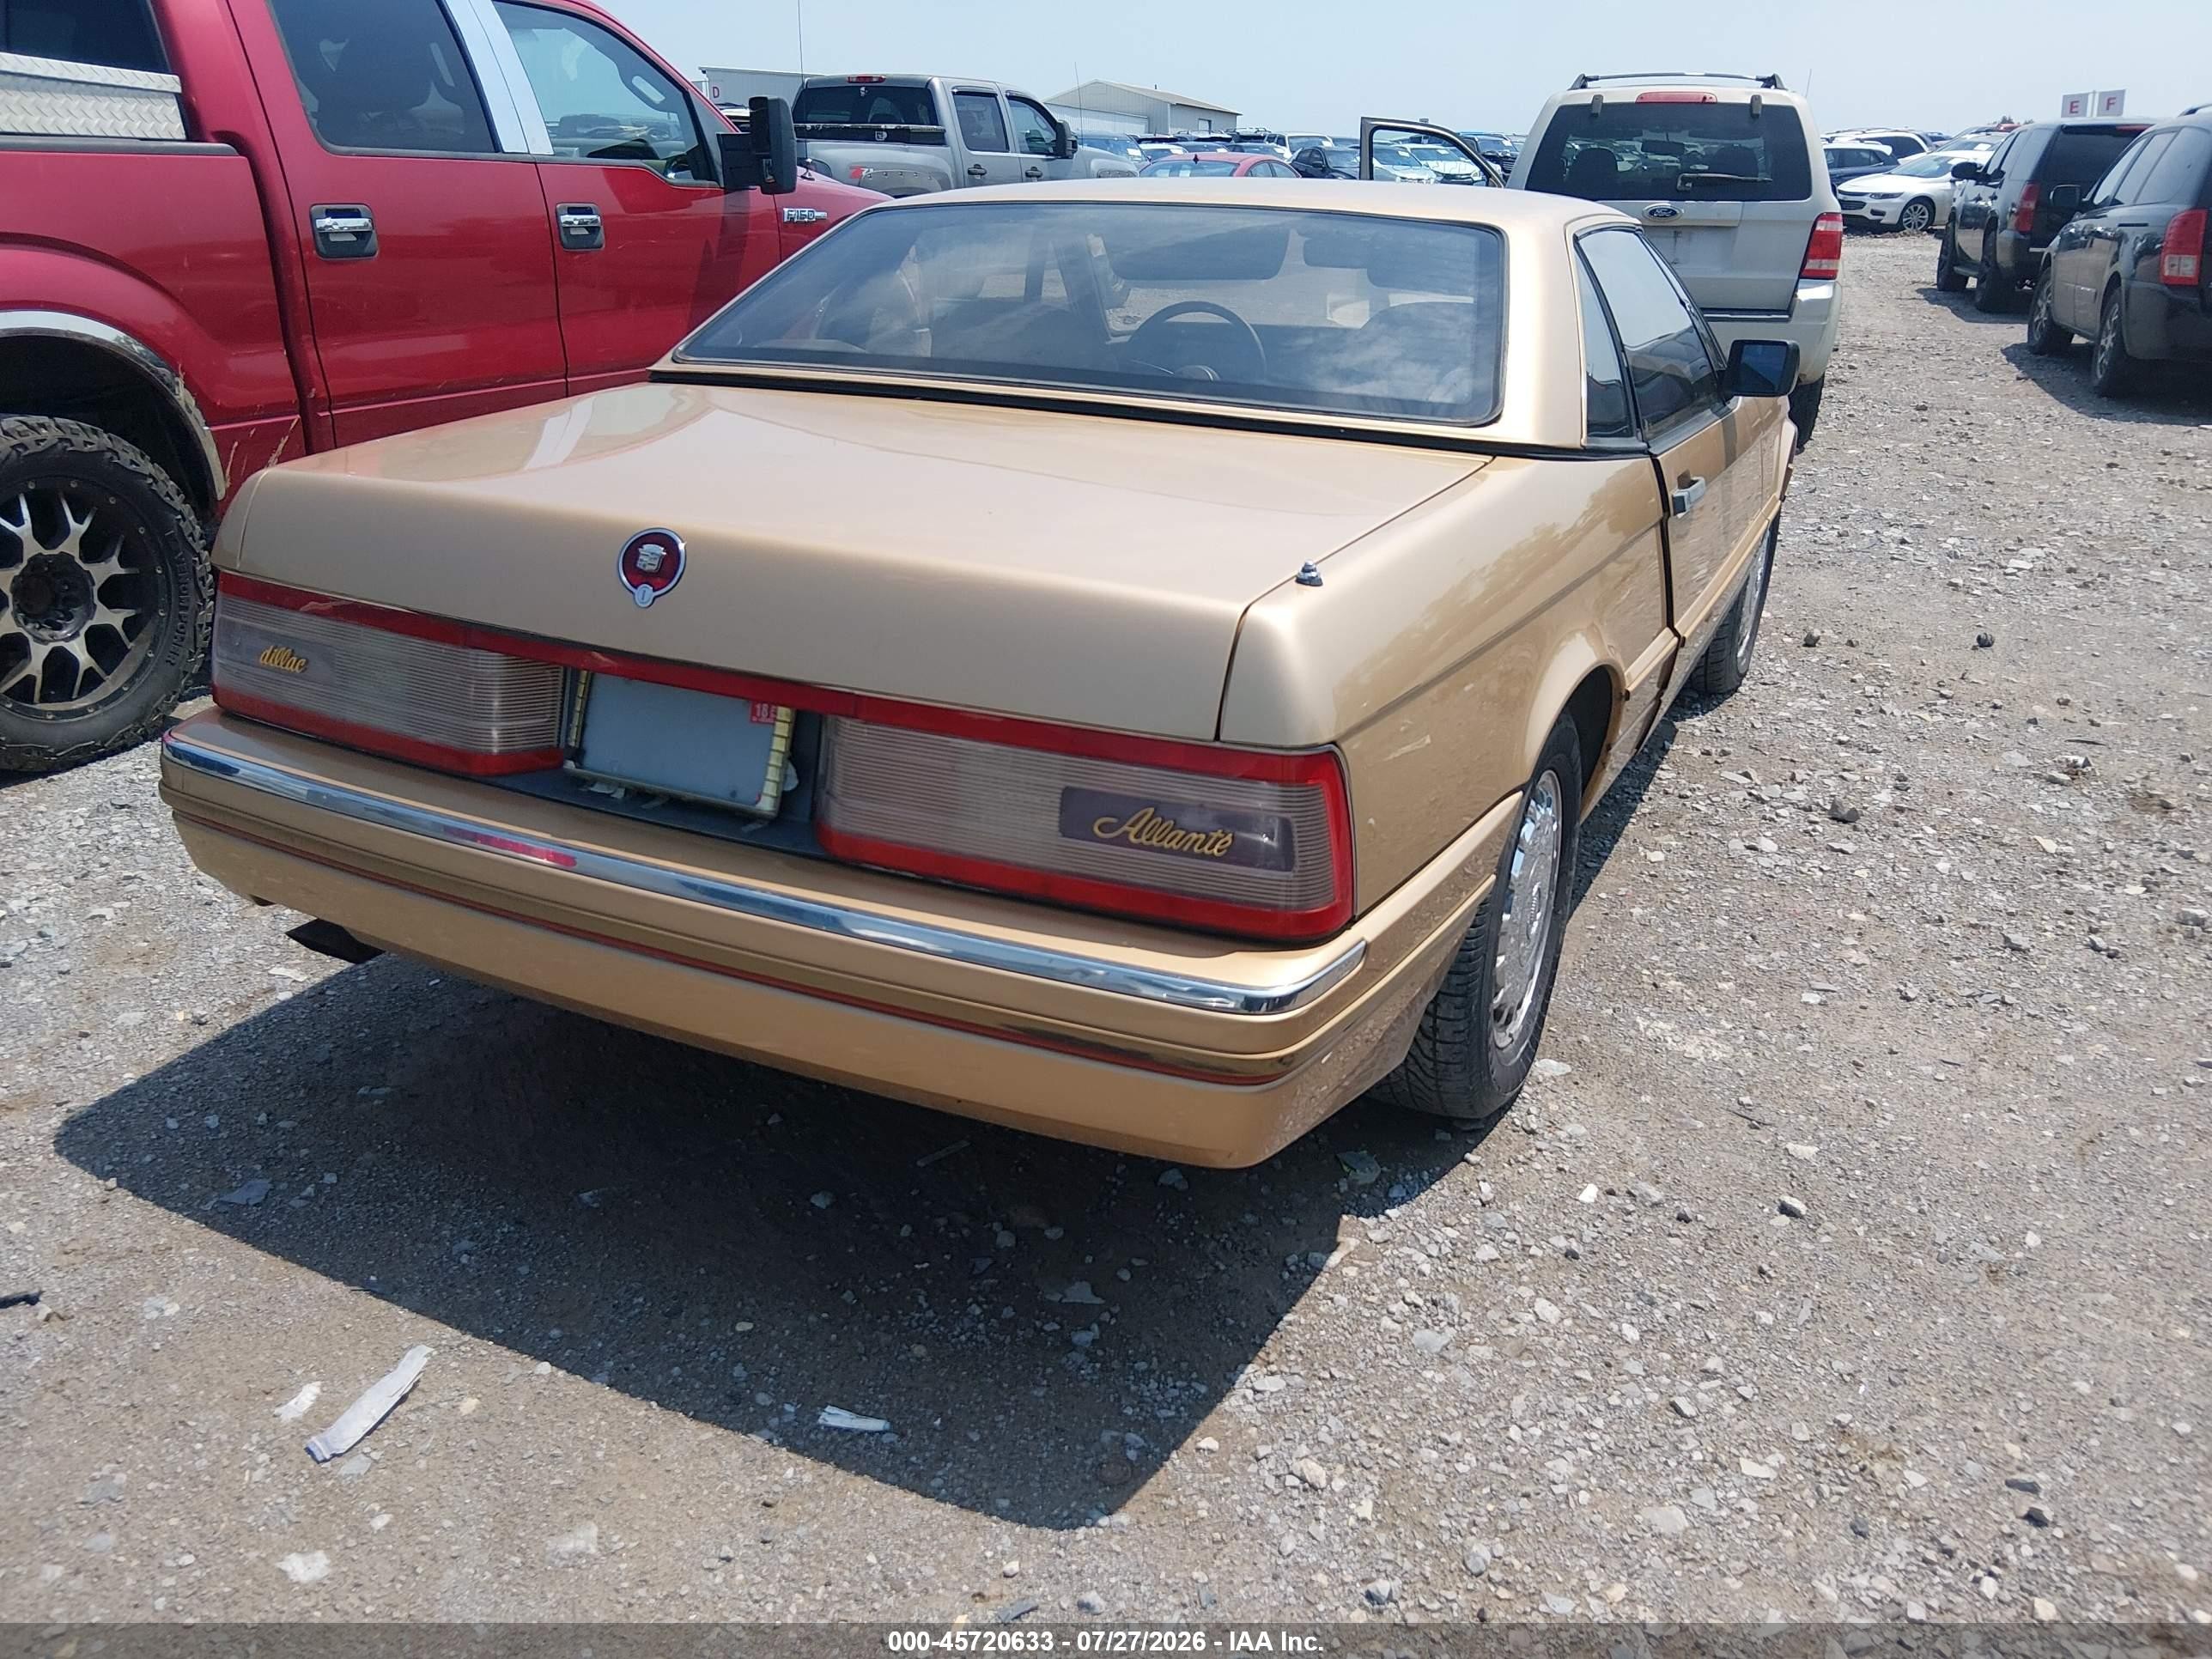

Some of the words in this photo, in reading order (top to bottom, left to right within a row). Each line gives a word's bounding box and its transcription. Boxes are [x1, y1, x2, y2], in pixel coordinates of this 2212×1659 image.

[712, 86, 720, 99] D
[2069, 100, 2080, 114] E
[2106, 96, 2117, 111] F
